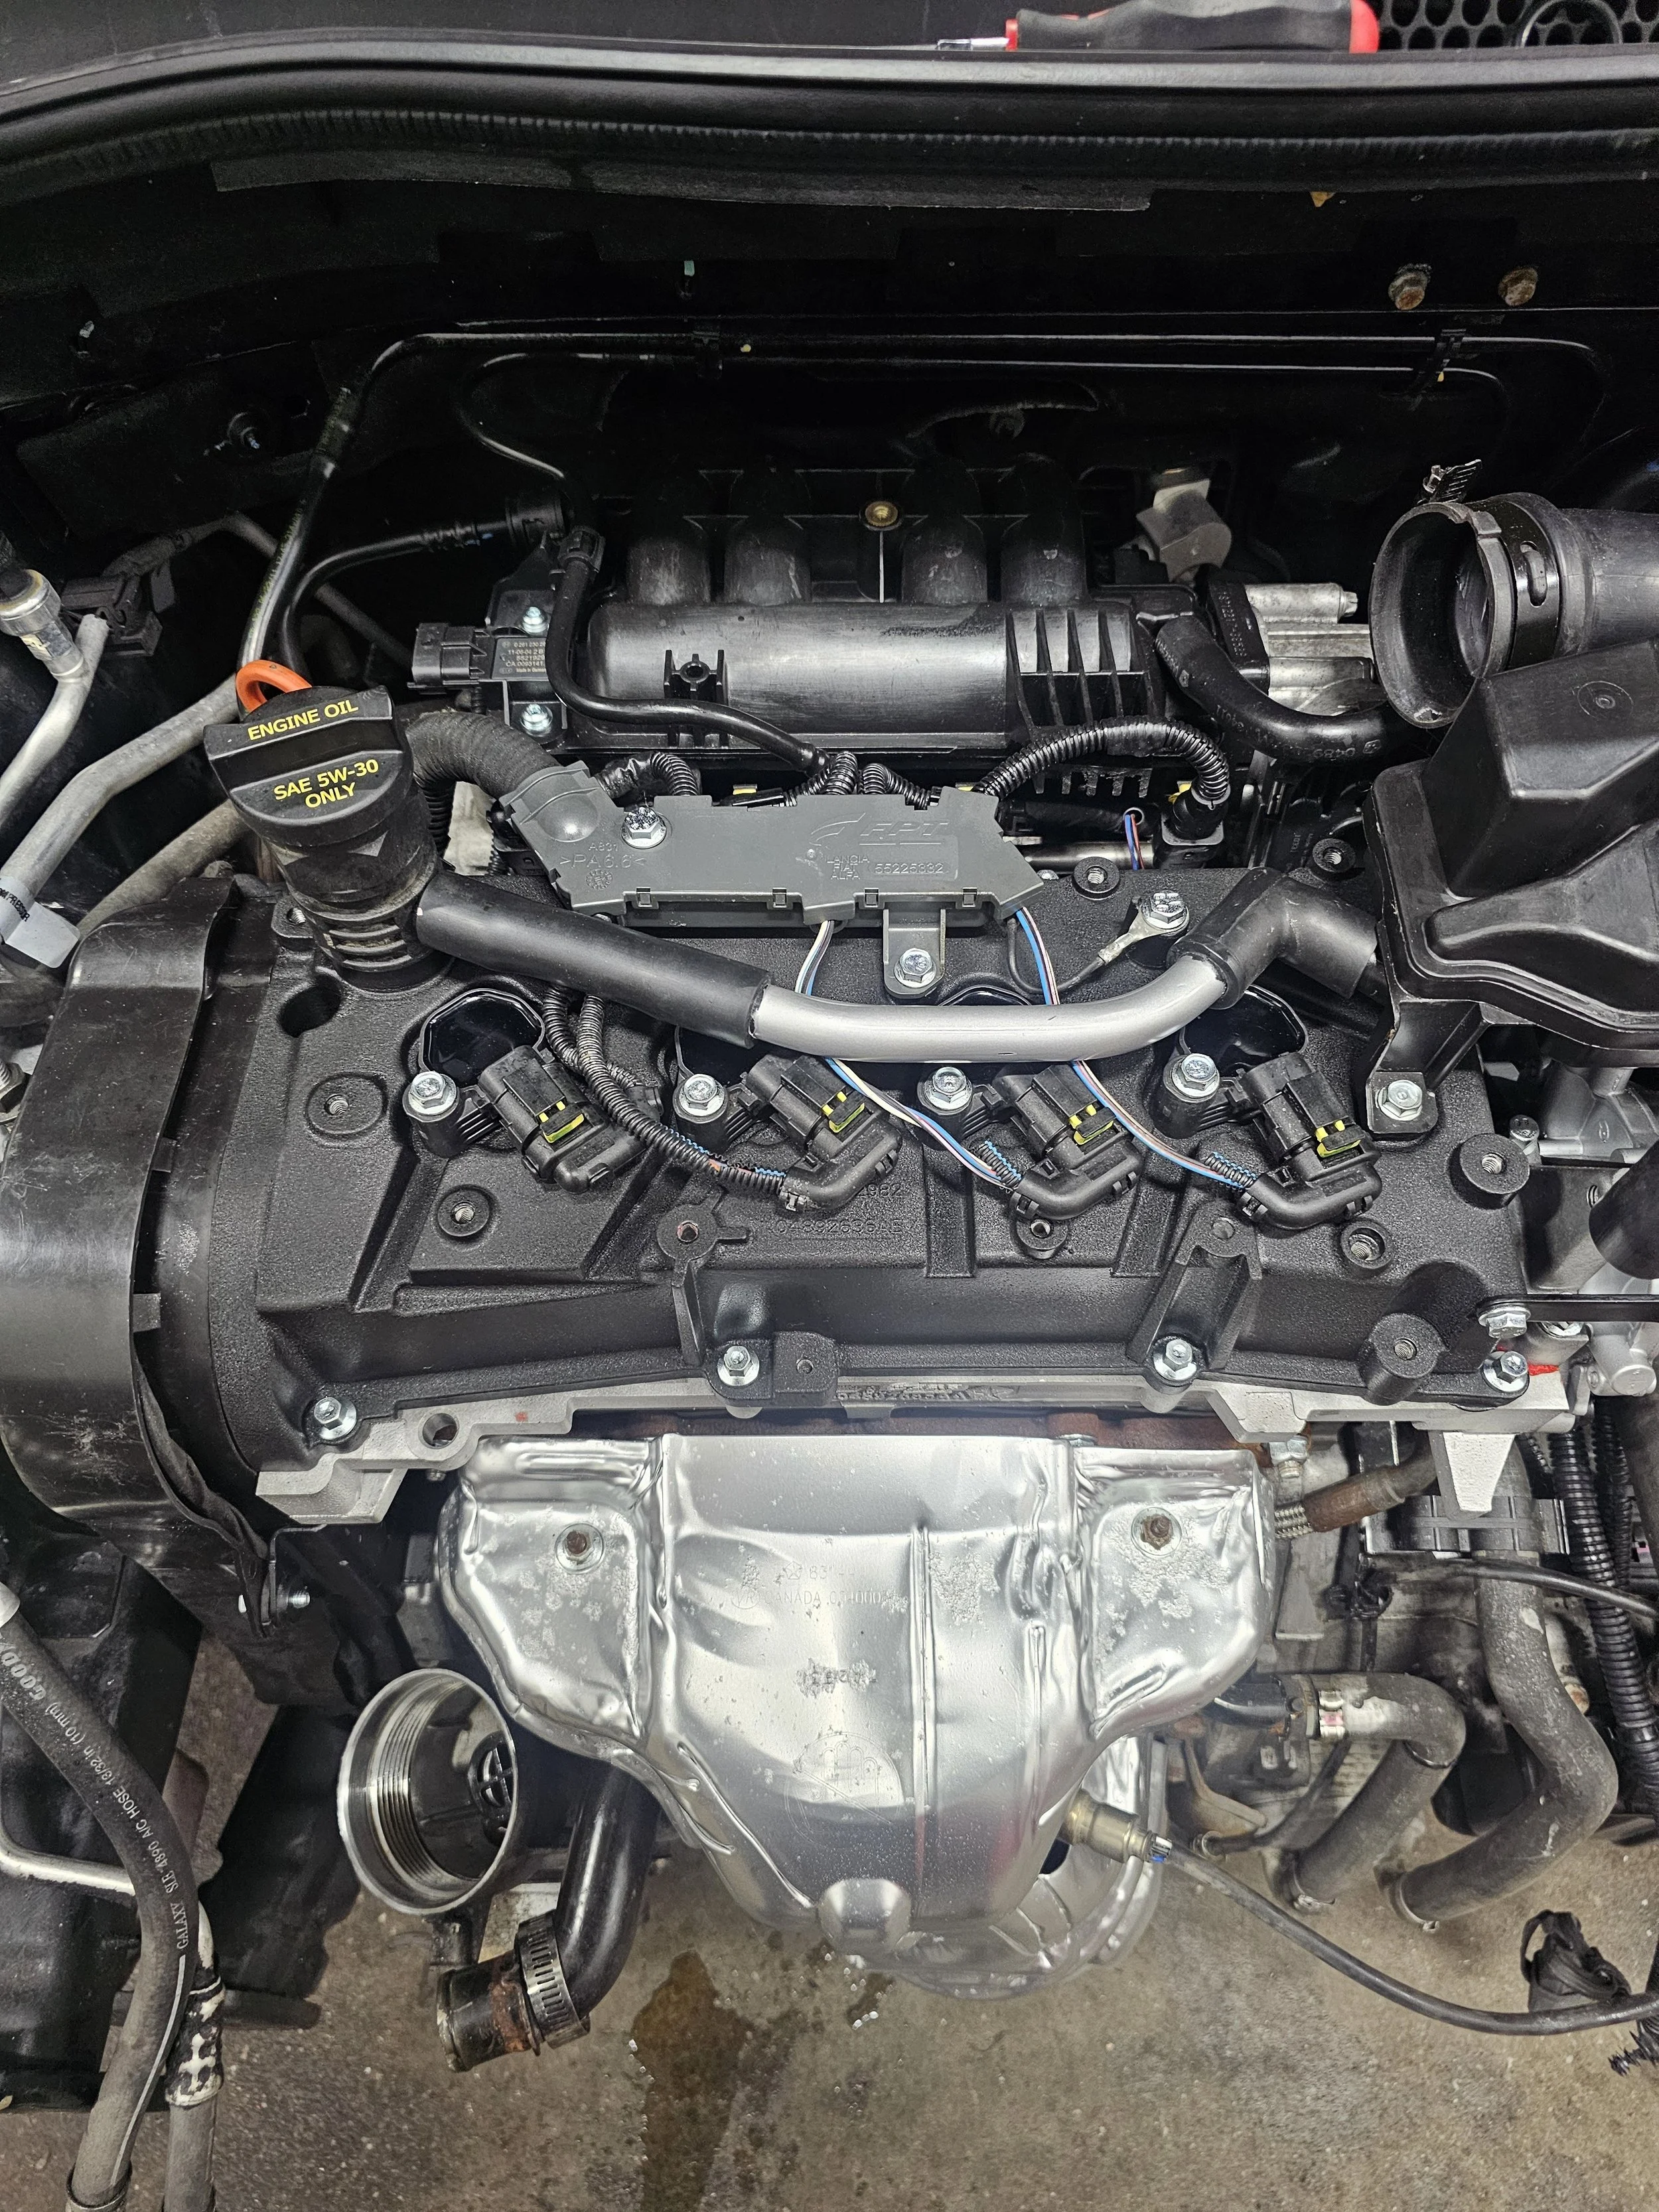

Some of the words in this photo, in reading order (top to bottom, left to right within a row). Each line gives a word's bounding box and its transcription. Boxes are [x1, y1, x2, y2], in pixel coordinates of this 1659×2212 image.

[248, 708, 321, 741] ENGINE
[324, 700, 359, 719] OIL
[273, 777, 313, 800] SAE
[317, 759, 379, 788] 5W-30
[305, 782, 356, 808] ONLY
[826, 854, 870, 863] LANCIA
[833, 863, 858, 872] FIAT
[875, 863, 944, 874] 55225332
[831, 871, 861, 880] ALFA
[84, 1745, 96, 1760] in
[90, 1755, 116, 1786] 13/32
[112, 1785, 141, 1819] HOSE
[135, 1818, 154, 1839] A/C
[148, 1840, 168, 1869] 4890
[170, 1903, 189, 1950] GALAXY
